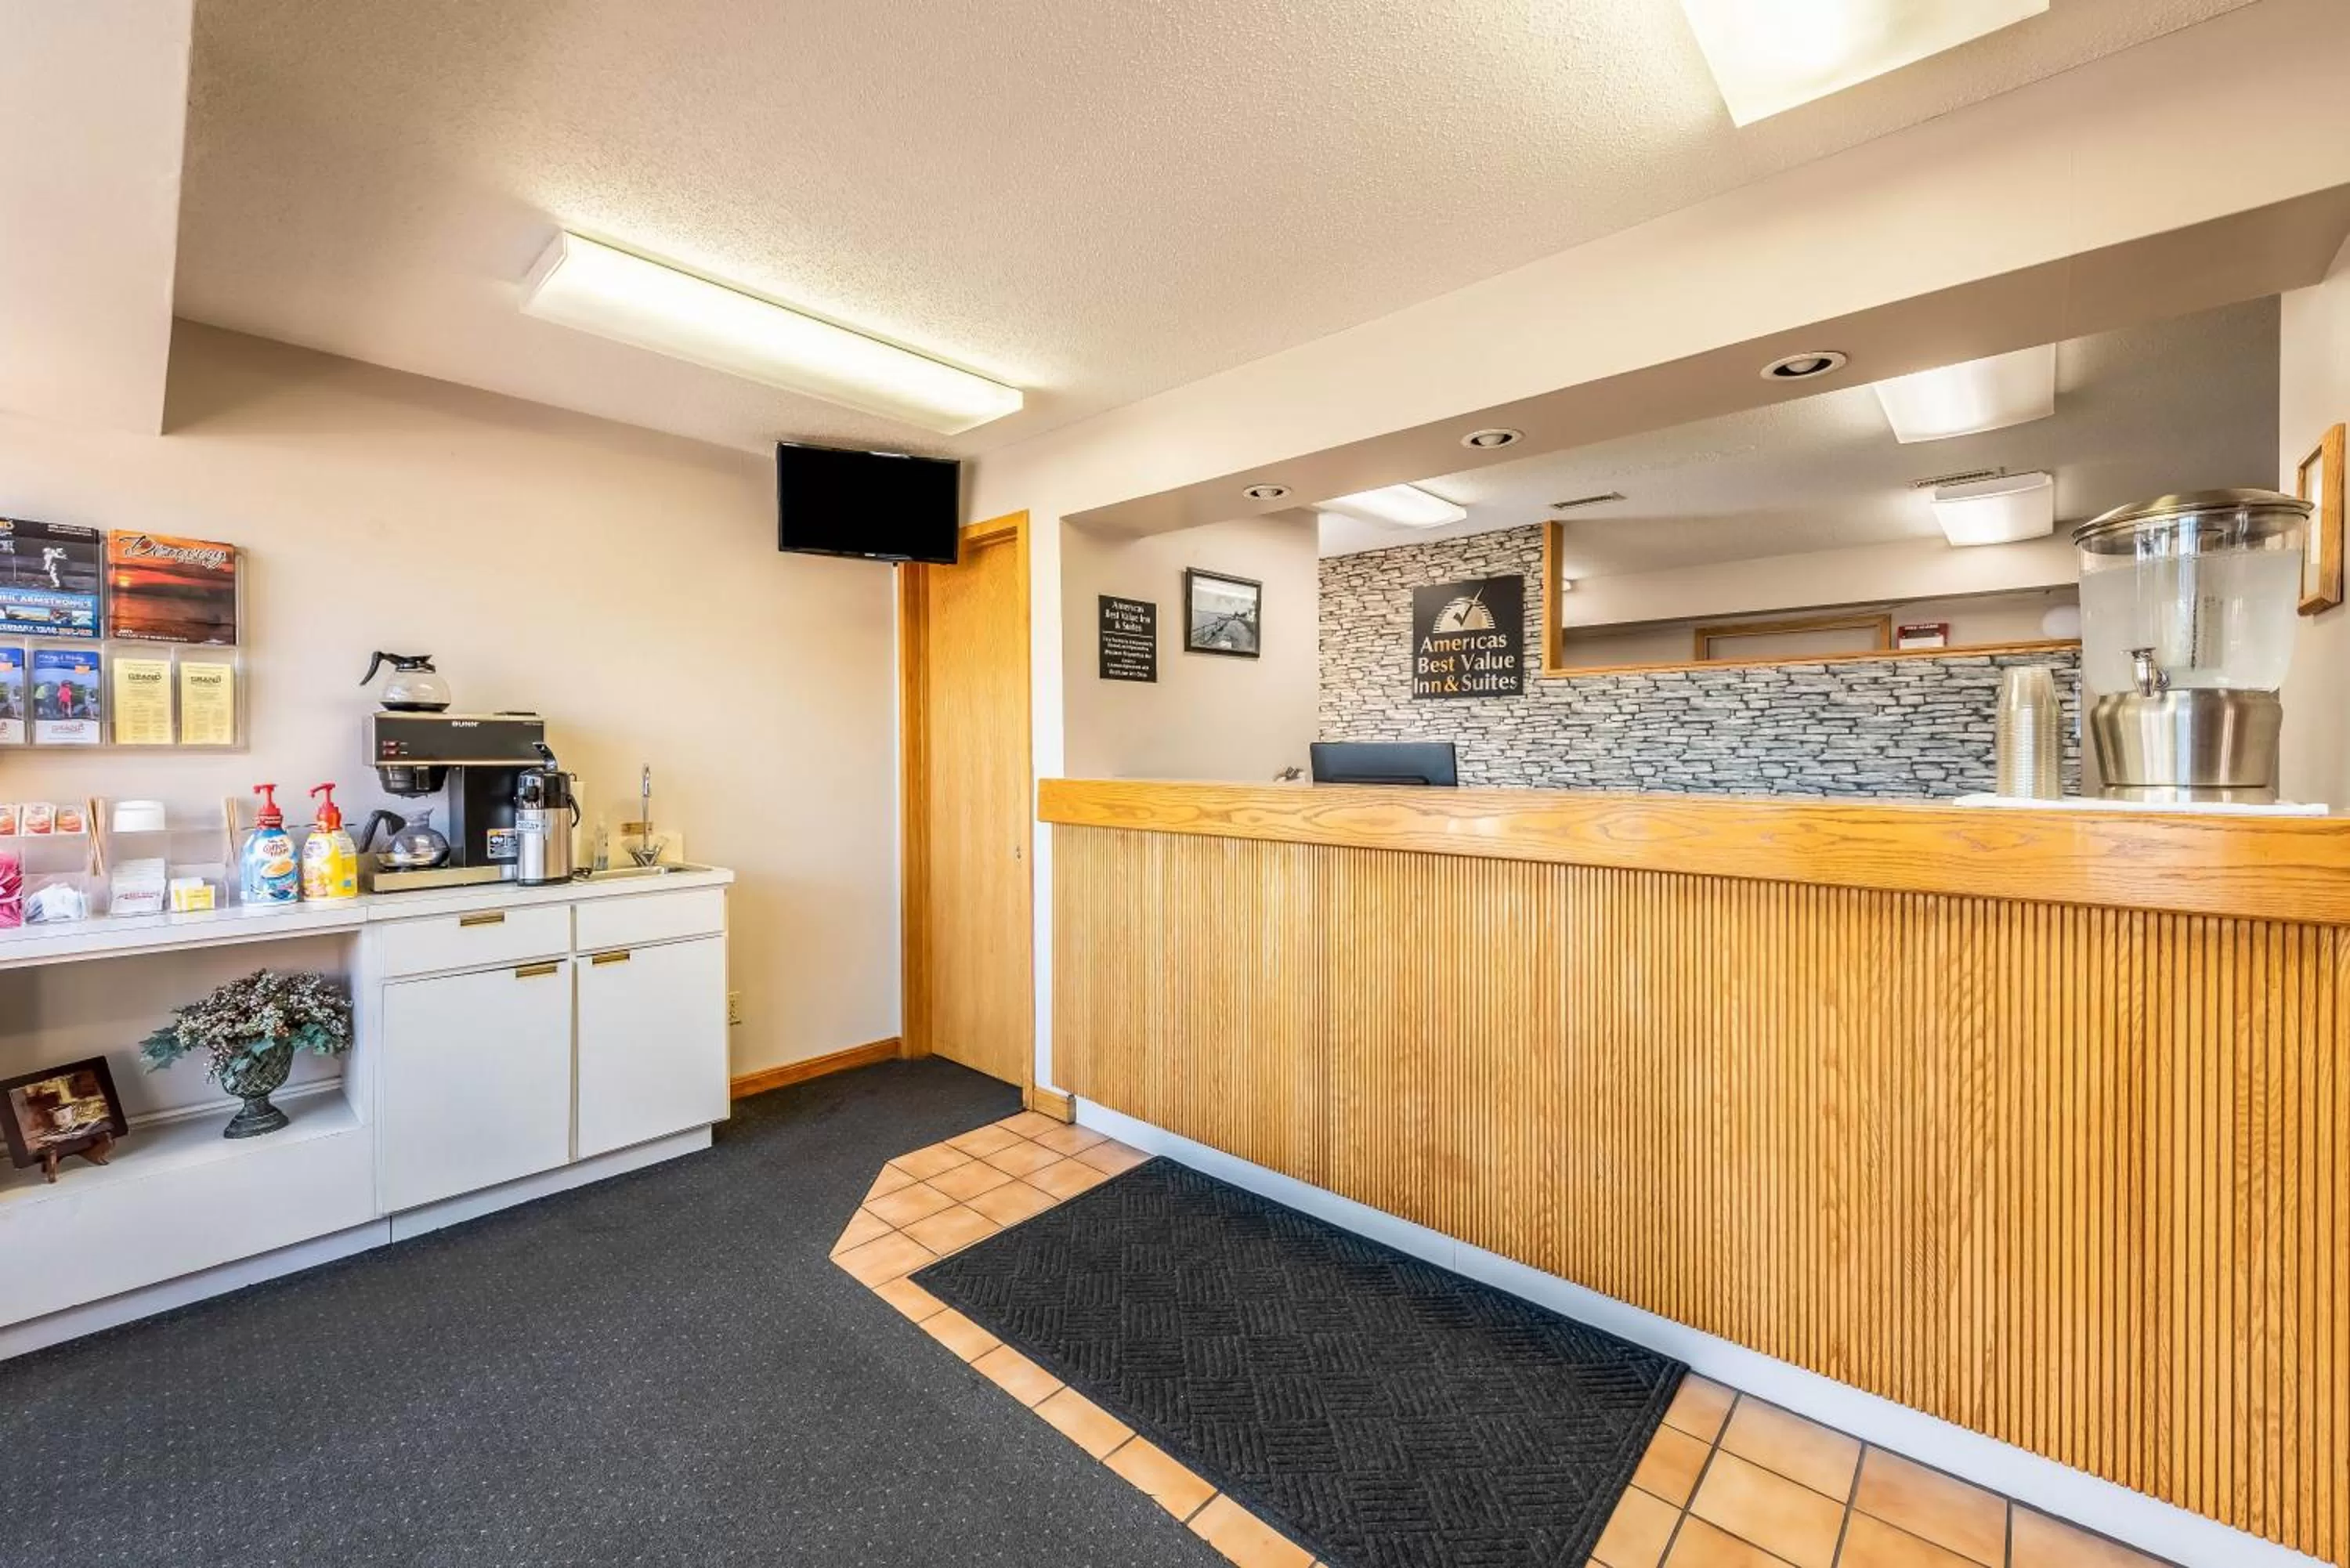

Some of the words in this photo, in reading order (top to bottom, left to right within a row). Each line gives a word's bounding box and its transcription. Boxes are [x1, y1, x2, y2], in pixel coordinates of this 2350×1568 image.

[1420, 634, 1508, 654] Americas
[1417, 655, 1455, 674] Best
[1460, 651, 1516, 671] Value
[1413, 677, 1442, 694] Inn
[1461, 673, 1518, 692] Suites
